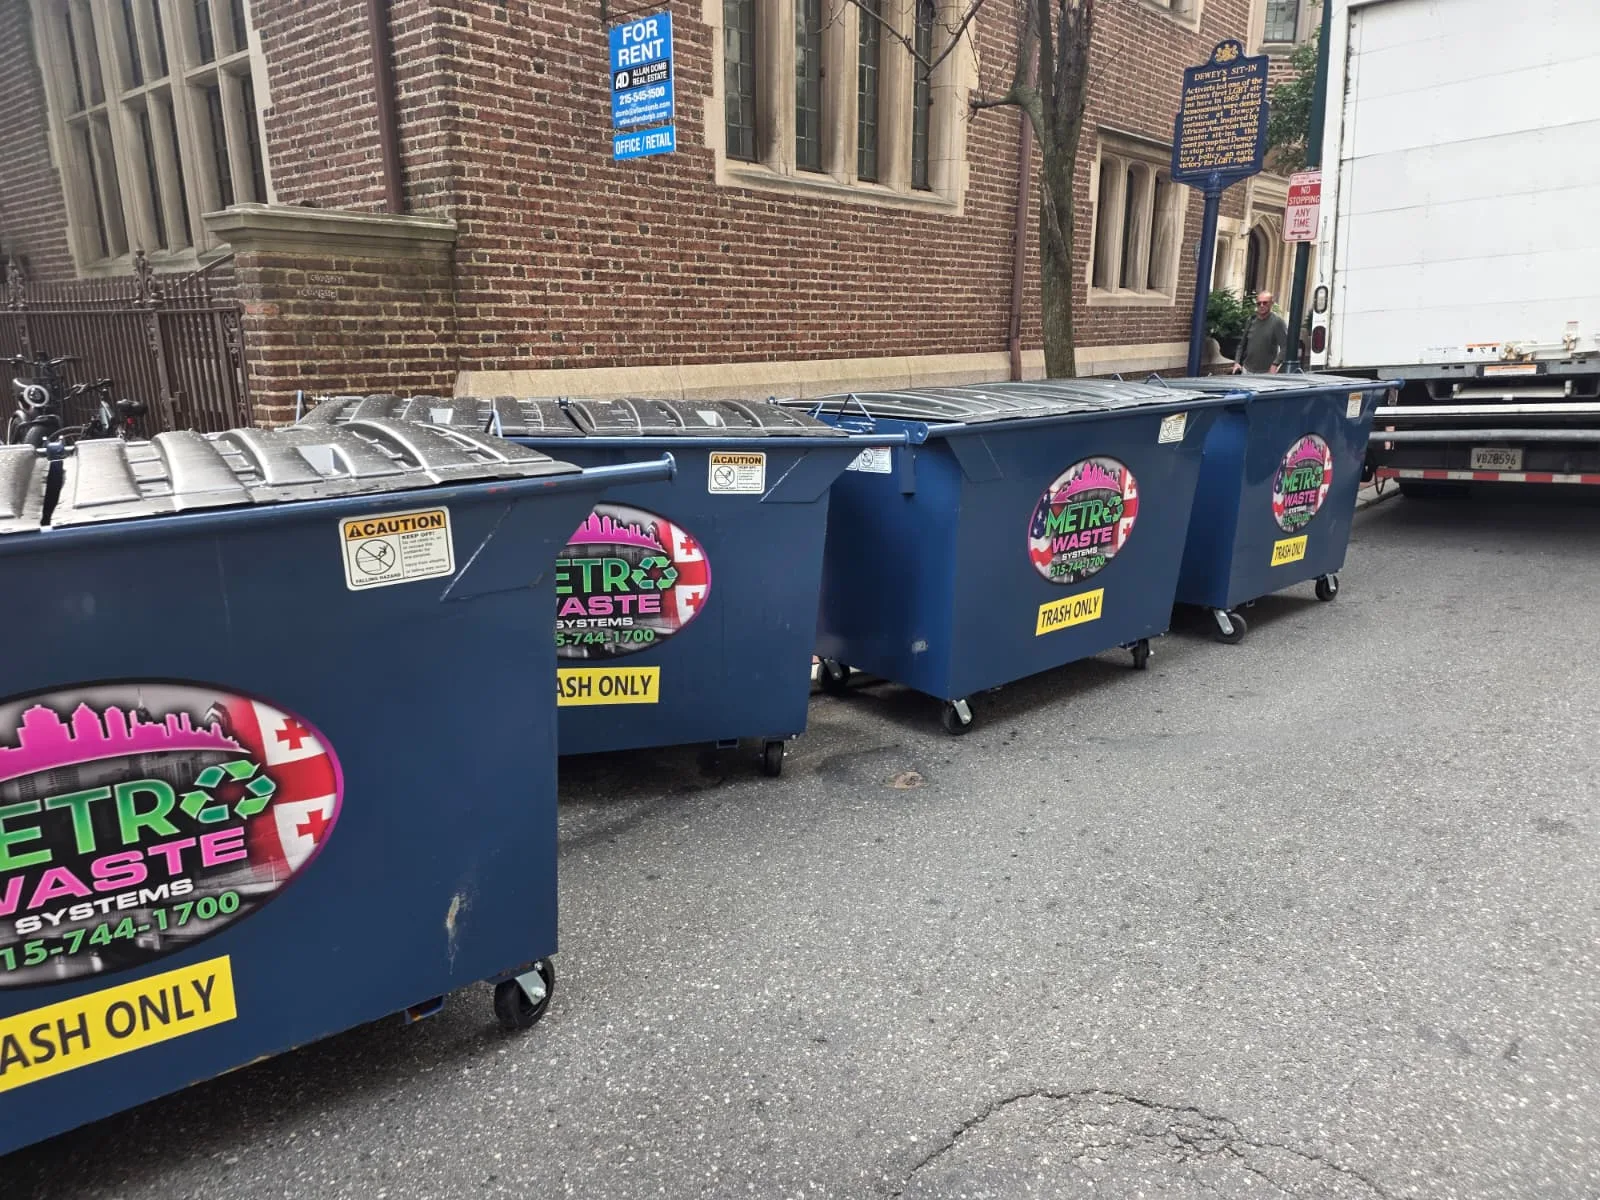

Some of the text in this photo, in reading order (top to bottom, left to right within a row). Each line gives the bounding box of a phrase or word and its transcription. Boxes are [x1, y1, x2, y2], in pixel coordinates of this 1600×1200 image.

[622, 19, 658, 45] FOR
[618, 38, 664, 67] RENT
[632, 61, 667, 77] ALLAN DOMB
[1194, 63, 1258, 81] DEWEY'S SIT-IN
[615, 71, 630, 90] AD
[632, 70, 667, 87] REAL ESTATE
[1185, 84, 1216, 95] Activists
[1216, 82, 1227, 91] led
[1241, 79, 1251, 88] of
[1251, 77, 1263, 85] the
[619, 86, 665, 105] 215-545-1500
[1196, 98, 1213, 107] here
[1223, 94, 1240, 103] 1965
[1241, 91, 1262, 100] after
[1212, 87, 1228, 98] first
[1229, 86, 1248, 96] LGBT
[1239, 98, 1262, 107] denied
[1183, 113, 1209, 122] service
[1215, 110, 1224, 118] at
[1249, 112, 1259, 122] by
[1182, 120, 1259, 136] African American lunch
[1182, 134, 1209, 142] counter
[1244, 127, 1258, 135] this
[615, 137, 641, 156] OFFICE
[645, 131, 672, 150] RETAIL
[1189, 145, 1205, 155] stop
[1205, 144, 1215, 152] its
[1197, 137, 1230, 148] prompted
[1180, 154, 1196, 164] tory
[1225, 150, 1235, 158] an
[1236, 147, 1256, 158] early
[1300, 186, 1311, 194] NO
[1288, 195, 1320, 205] STOPPING
[1294, 208, 1311, 218] ANY
[1293, 218, 1310, 228] TIME
[721, 456, 762, 465] CAUTION
[1284, 490, 1316, 508] WASTE
[363, 514, 442, 536] CAUTION
[1052, 526, 1113, 554] WASTE
[1062, 546, 1098, 561] SYSTEMS
[1274, 540, 1305, 561] TRASH ONLY
[1050, 555, 1105, 578] 215-744-1700
[557, 594, 661, 617] ASTE
[1041, 595, 1100, 628] TRASH ONLY
[556, 629, 655, 647] 5-744-1700
[557, 674, 652, 699] ASH ONLY
[15, 878, 194, 935] SYSTEMS
[0, 891, 240, 972] 15-744-1700
[0, 973, 216, 1076] ASH ONLY
